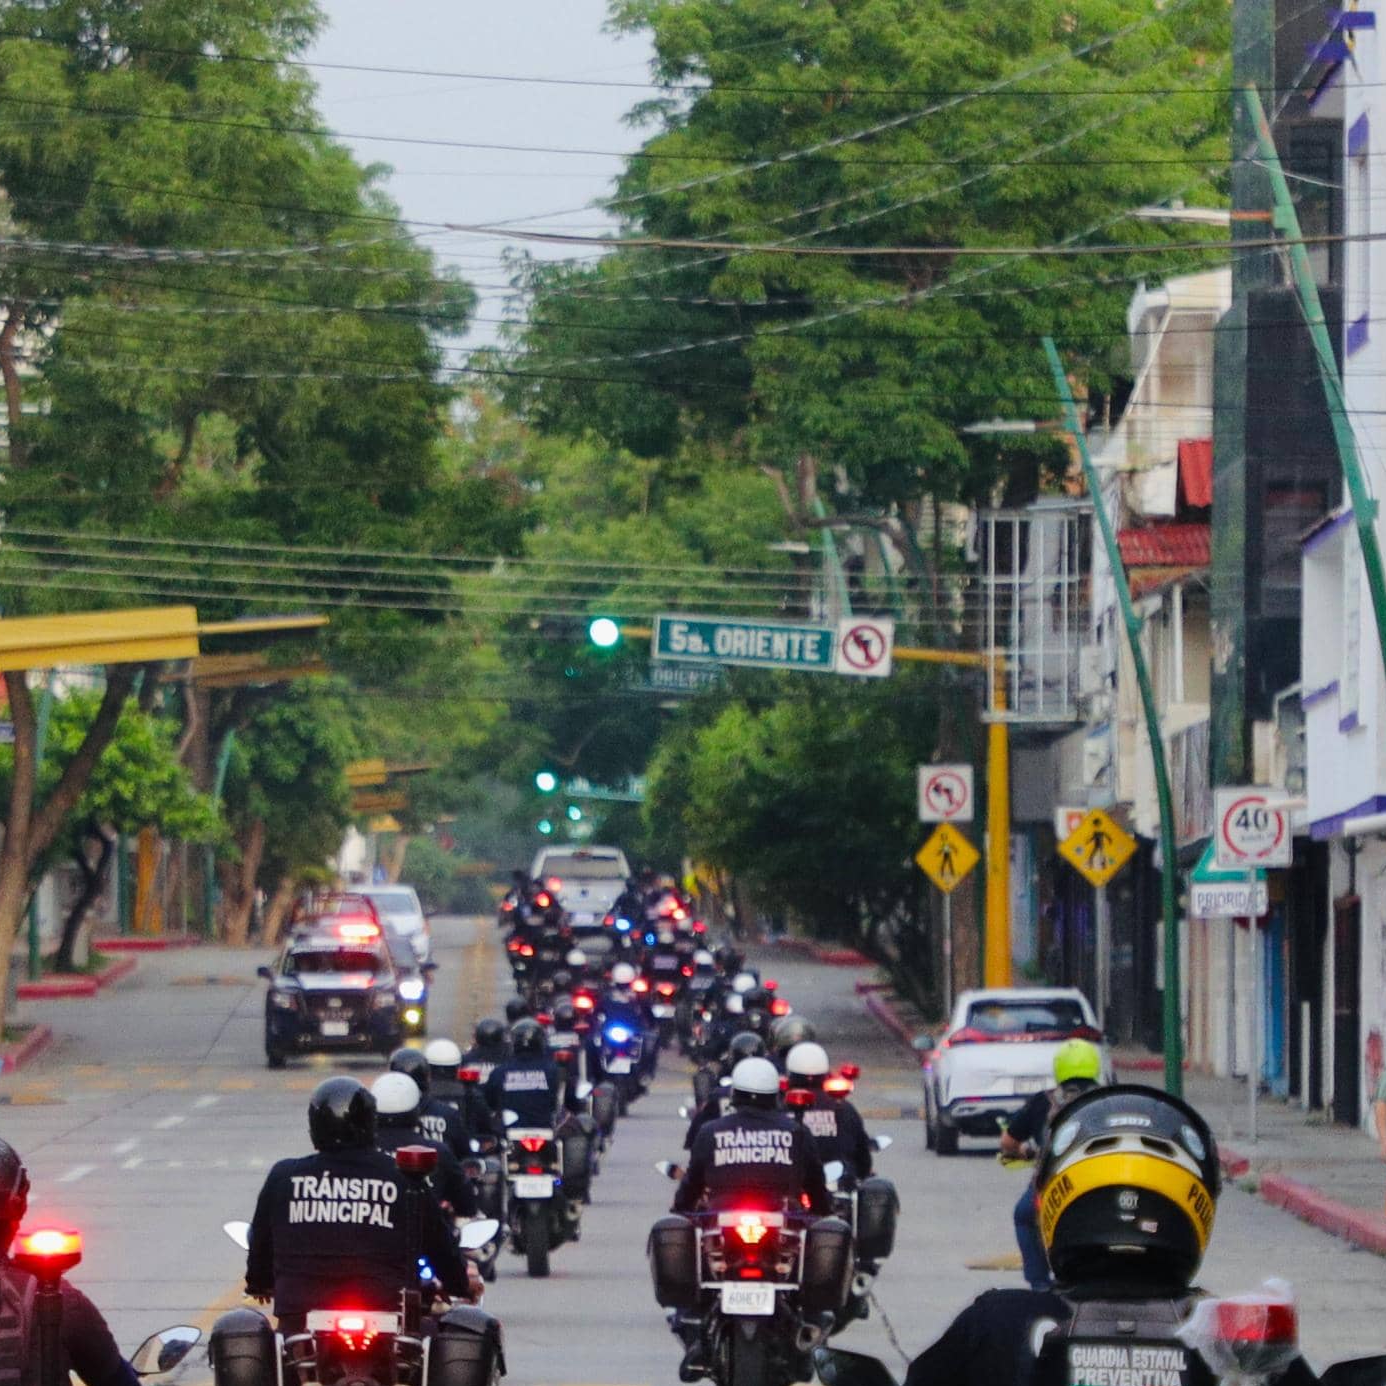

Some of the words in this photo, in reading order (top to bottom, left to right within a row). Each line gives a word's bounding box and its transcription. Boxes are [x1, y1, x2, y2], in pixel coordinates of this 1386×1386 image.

[668, 623, 710, 653] 5a.
[716, 626, 823, 661] ORIENTE
[1235, 807, 1269, 831] 40
[714, 1128, 794, 1148] TRÁNSITO
[714, 1147, 794, 1167] MUNICIPAL
[290, 1170, 398, 1203] TRÁNSITO
[289, 1200, 394, 1229] MUNICIPAL
[1072, 1347, 1129, 1368] GUARDIA
[1132, 1349, 1188, 1371] ESTATAL
